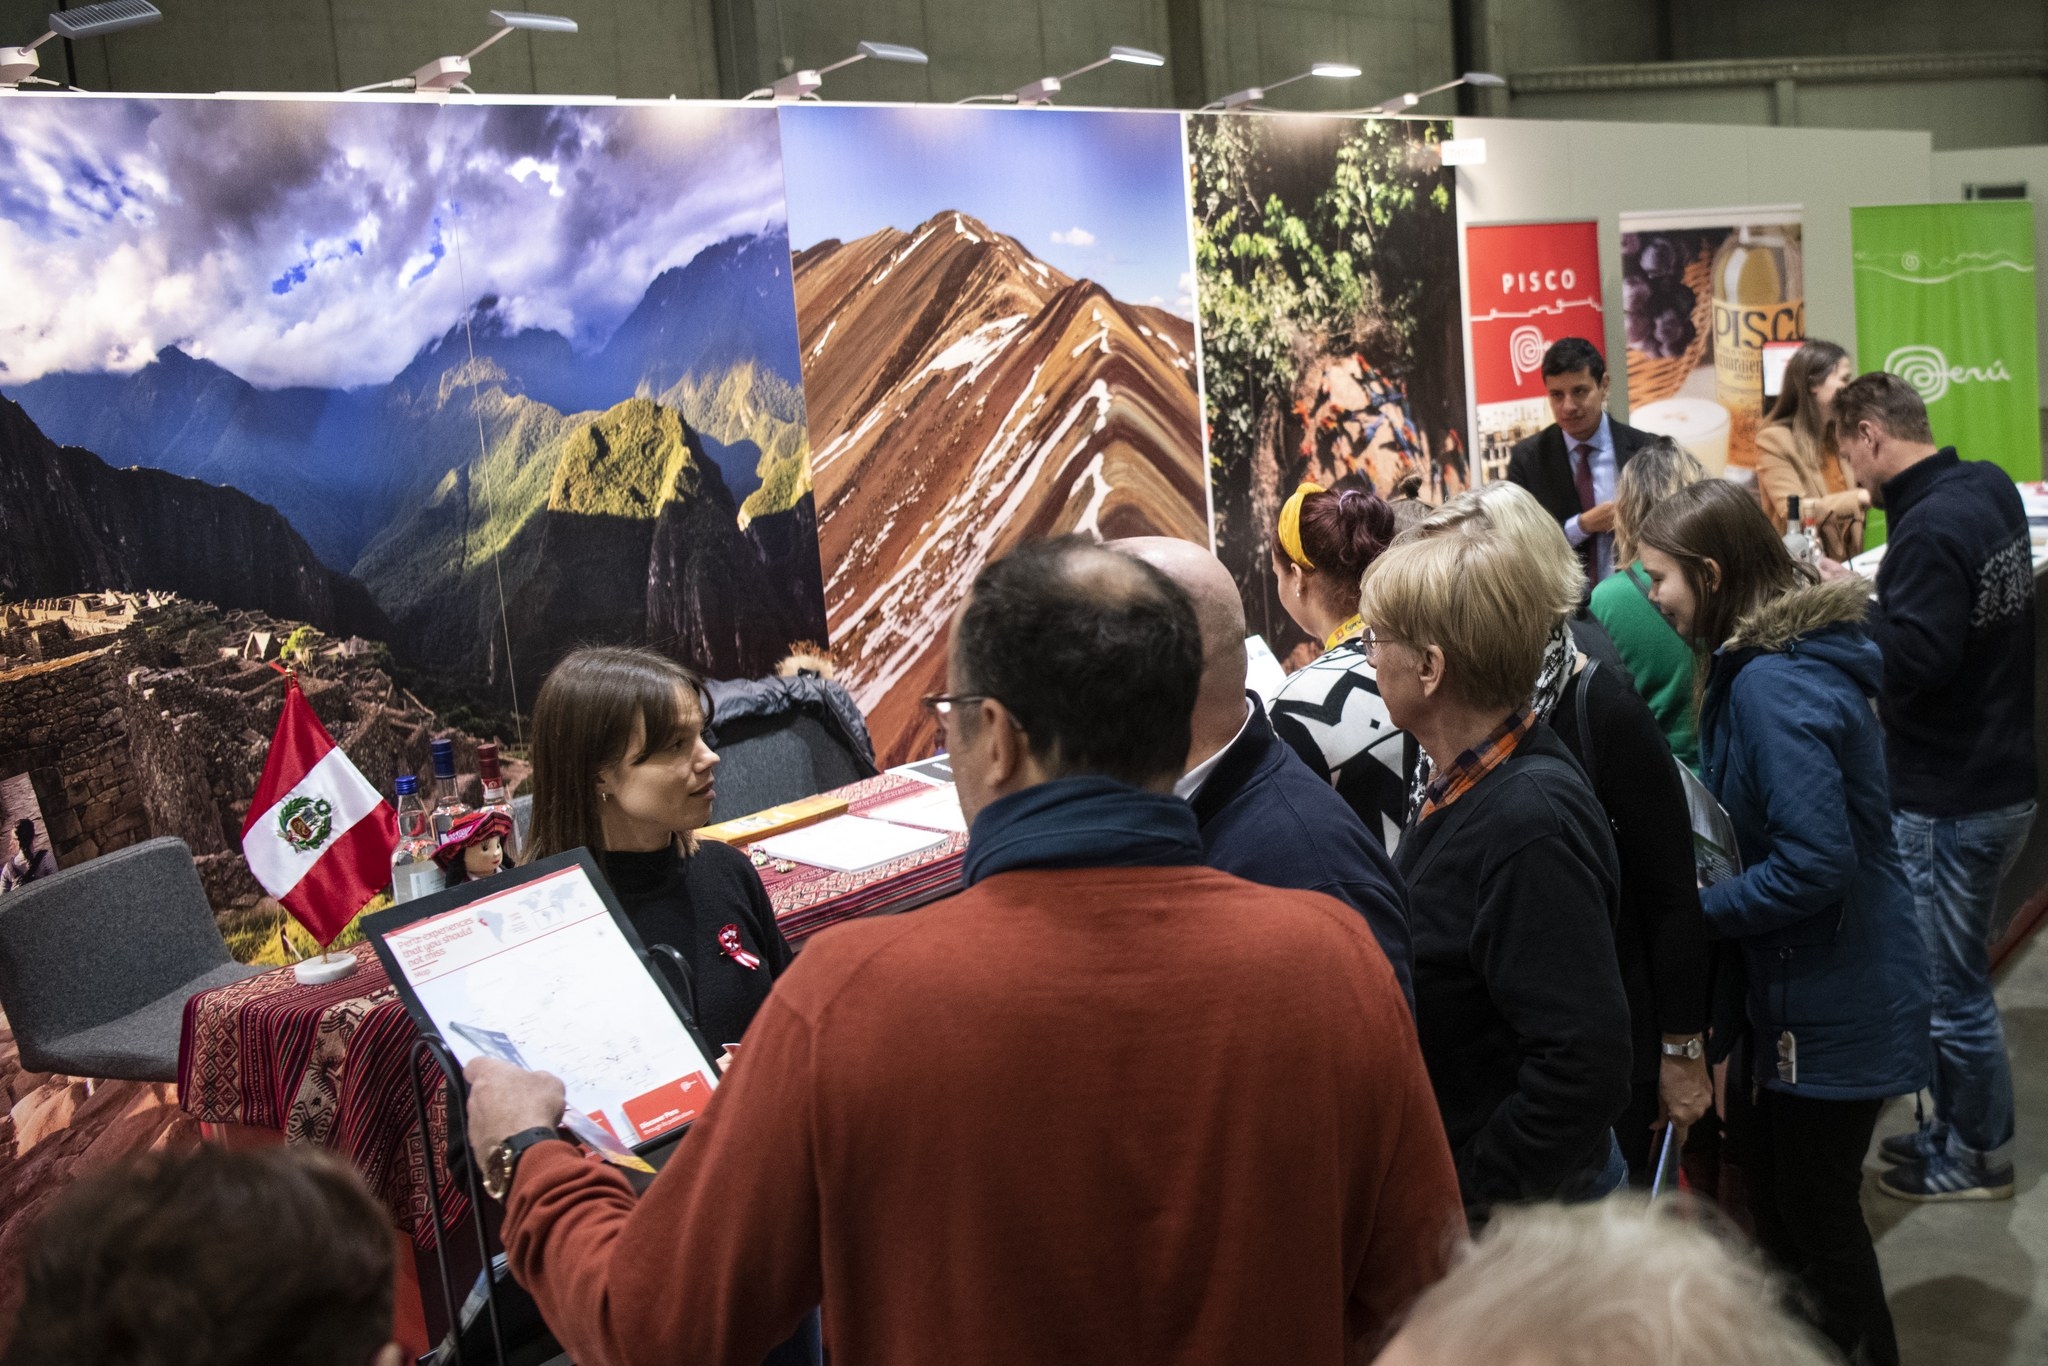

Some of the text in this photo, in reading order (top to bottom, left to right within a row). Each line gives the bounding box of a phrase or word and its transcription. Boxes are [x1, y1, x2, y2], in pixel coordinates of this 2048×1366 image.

[1502, 268, 1576, 294] PISCO
[422, 918, 474, 941] experiences
[402, 927, 473, 958] that you should
[408, 949, 446, 967] not miss
